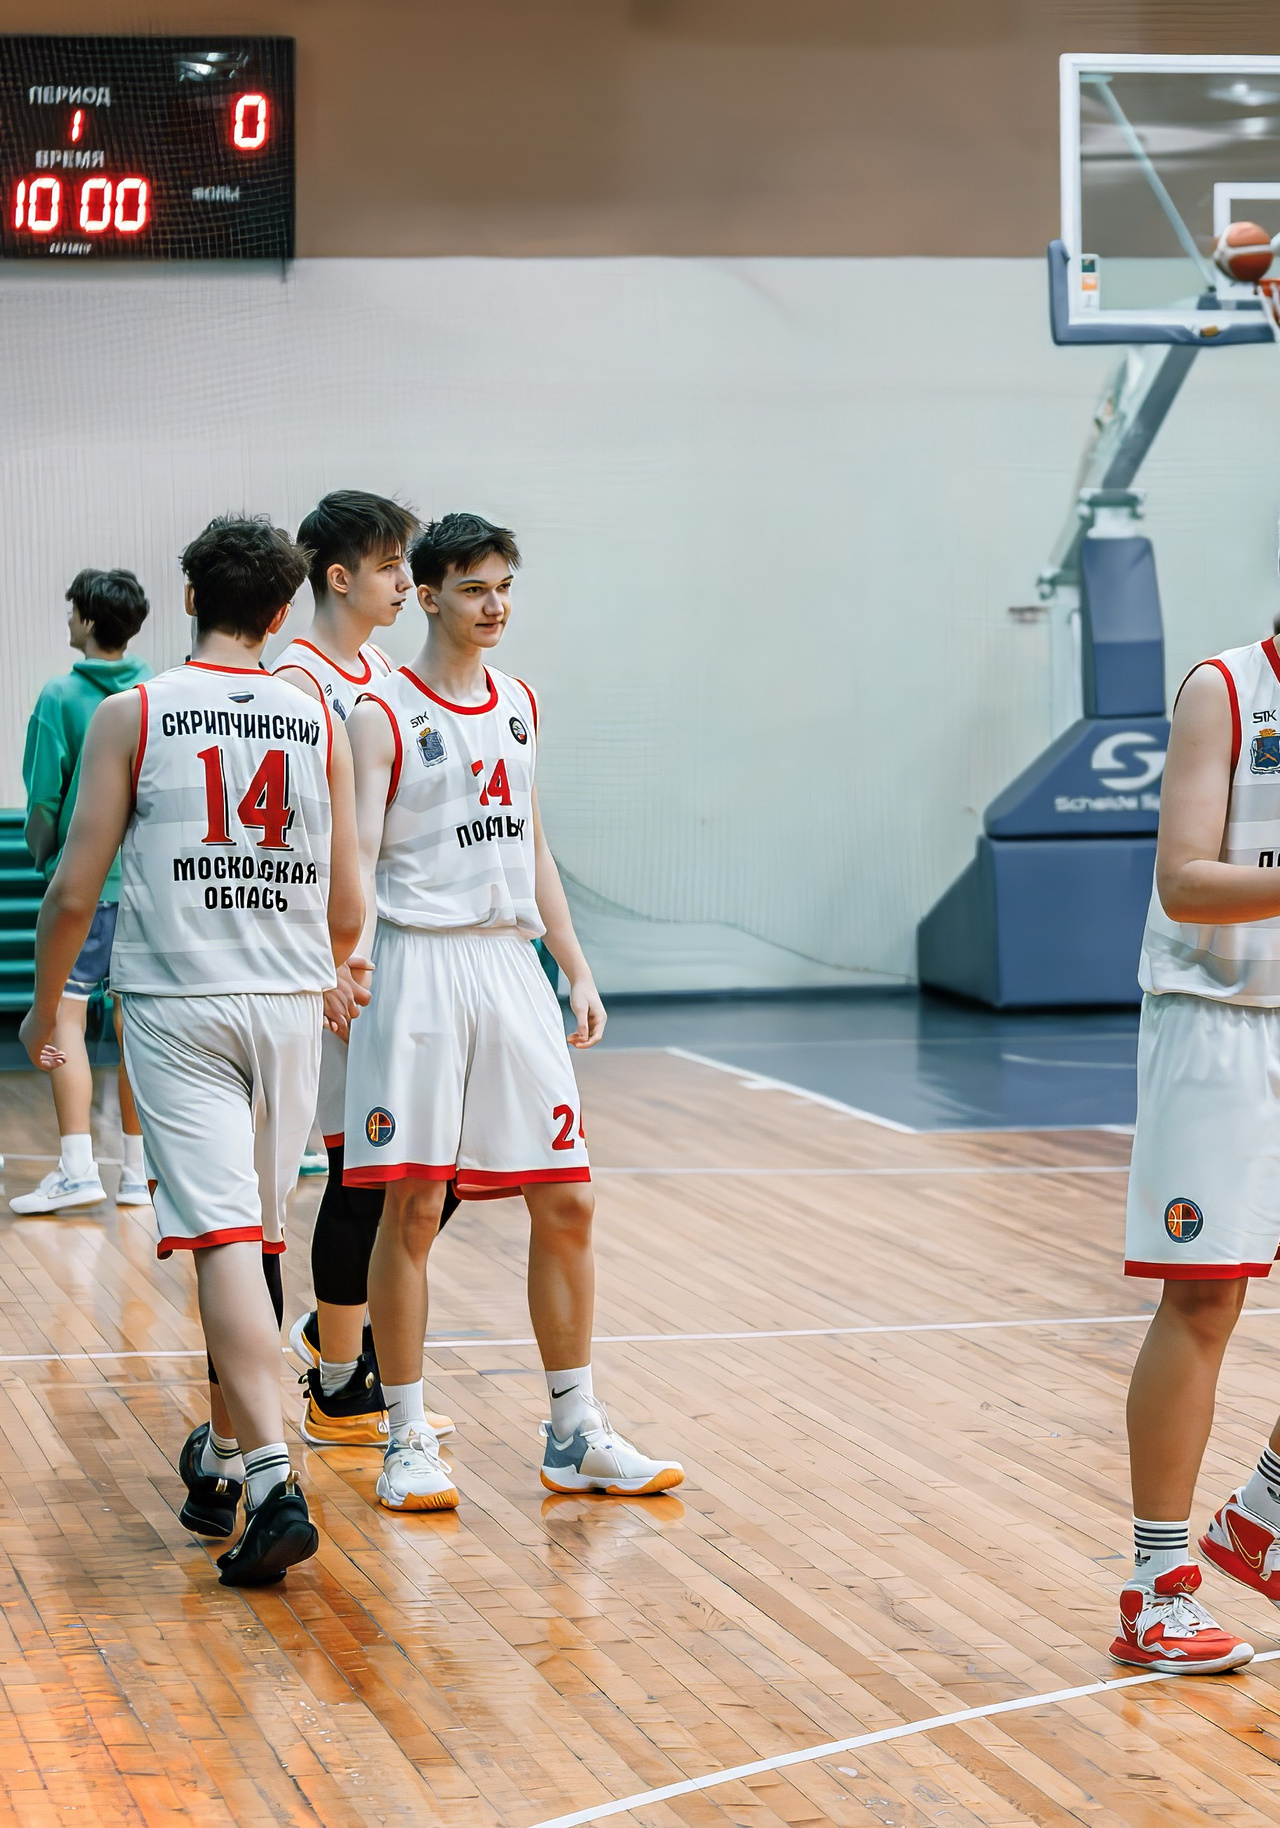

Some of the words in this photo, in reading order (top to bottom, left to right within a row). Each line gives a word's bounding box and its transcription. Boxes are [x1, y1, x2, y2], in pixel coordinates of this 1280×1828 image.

[71, 109, 83, 142] 1
[233, 94, 267, 149] 0
[162, 710, 320, 747] СКРИПЧИНСКИЙ
[196, 744, 296, 852] 14
